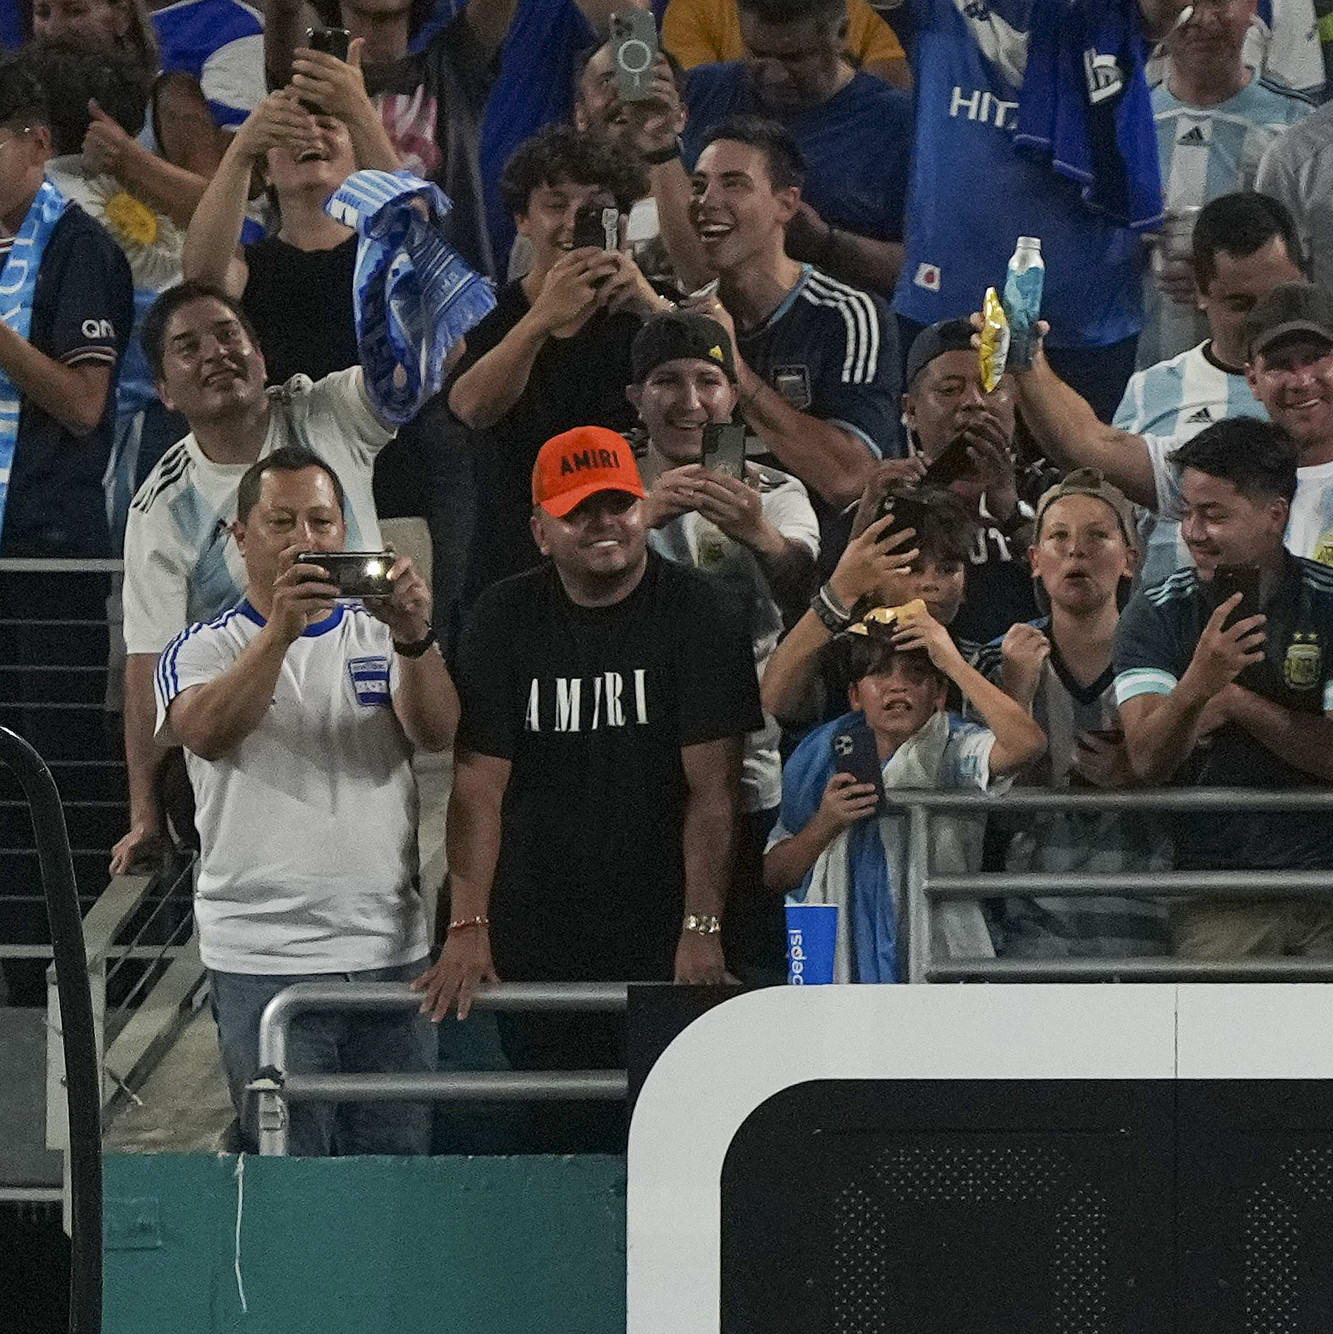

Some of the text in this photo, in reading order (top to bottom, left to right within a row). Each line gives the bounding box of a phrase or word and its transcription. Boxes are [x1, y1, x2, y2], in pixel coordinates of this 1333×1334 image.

[950, 86, 1019, 130] HIT
[561, 448, 621, 476] AMIRI
[524, 668, 650, 733] AMIRI
